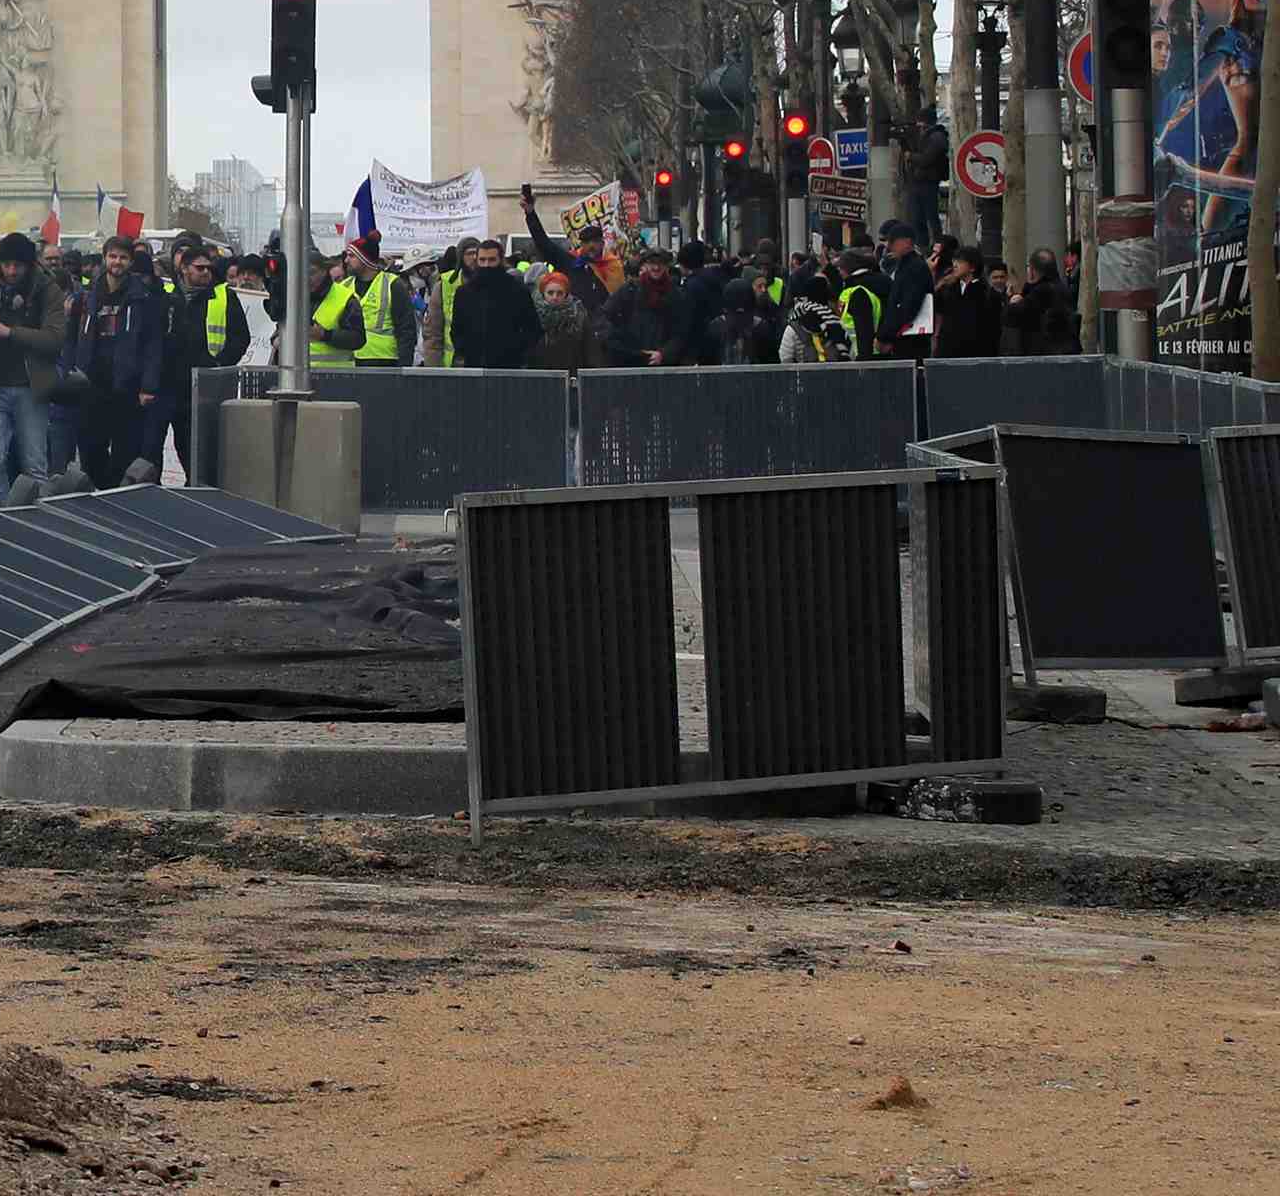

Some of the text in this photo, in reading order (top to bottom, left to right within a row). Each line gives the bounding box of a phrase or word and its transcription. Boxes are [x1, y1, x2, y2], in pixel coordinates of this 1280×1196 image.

[1202, 241, 1243, 266] TITANIC
[1156, 259, 1250, 320] ALIT
[1159, 340, 1169, 355] LE
[1172, 340, 1183, 355] 13
[1186, 337, 1225, 355] FÉVRIER
[1227, 339, 1240, 355] AU
